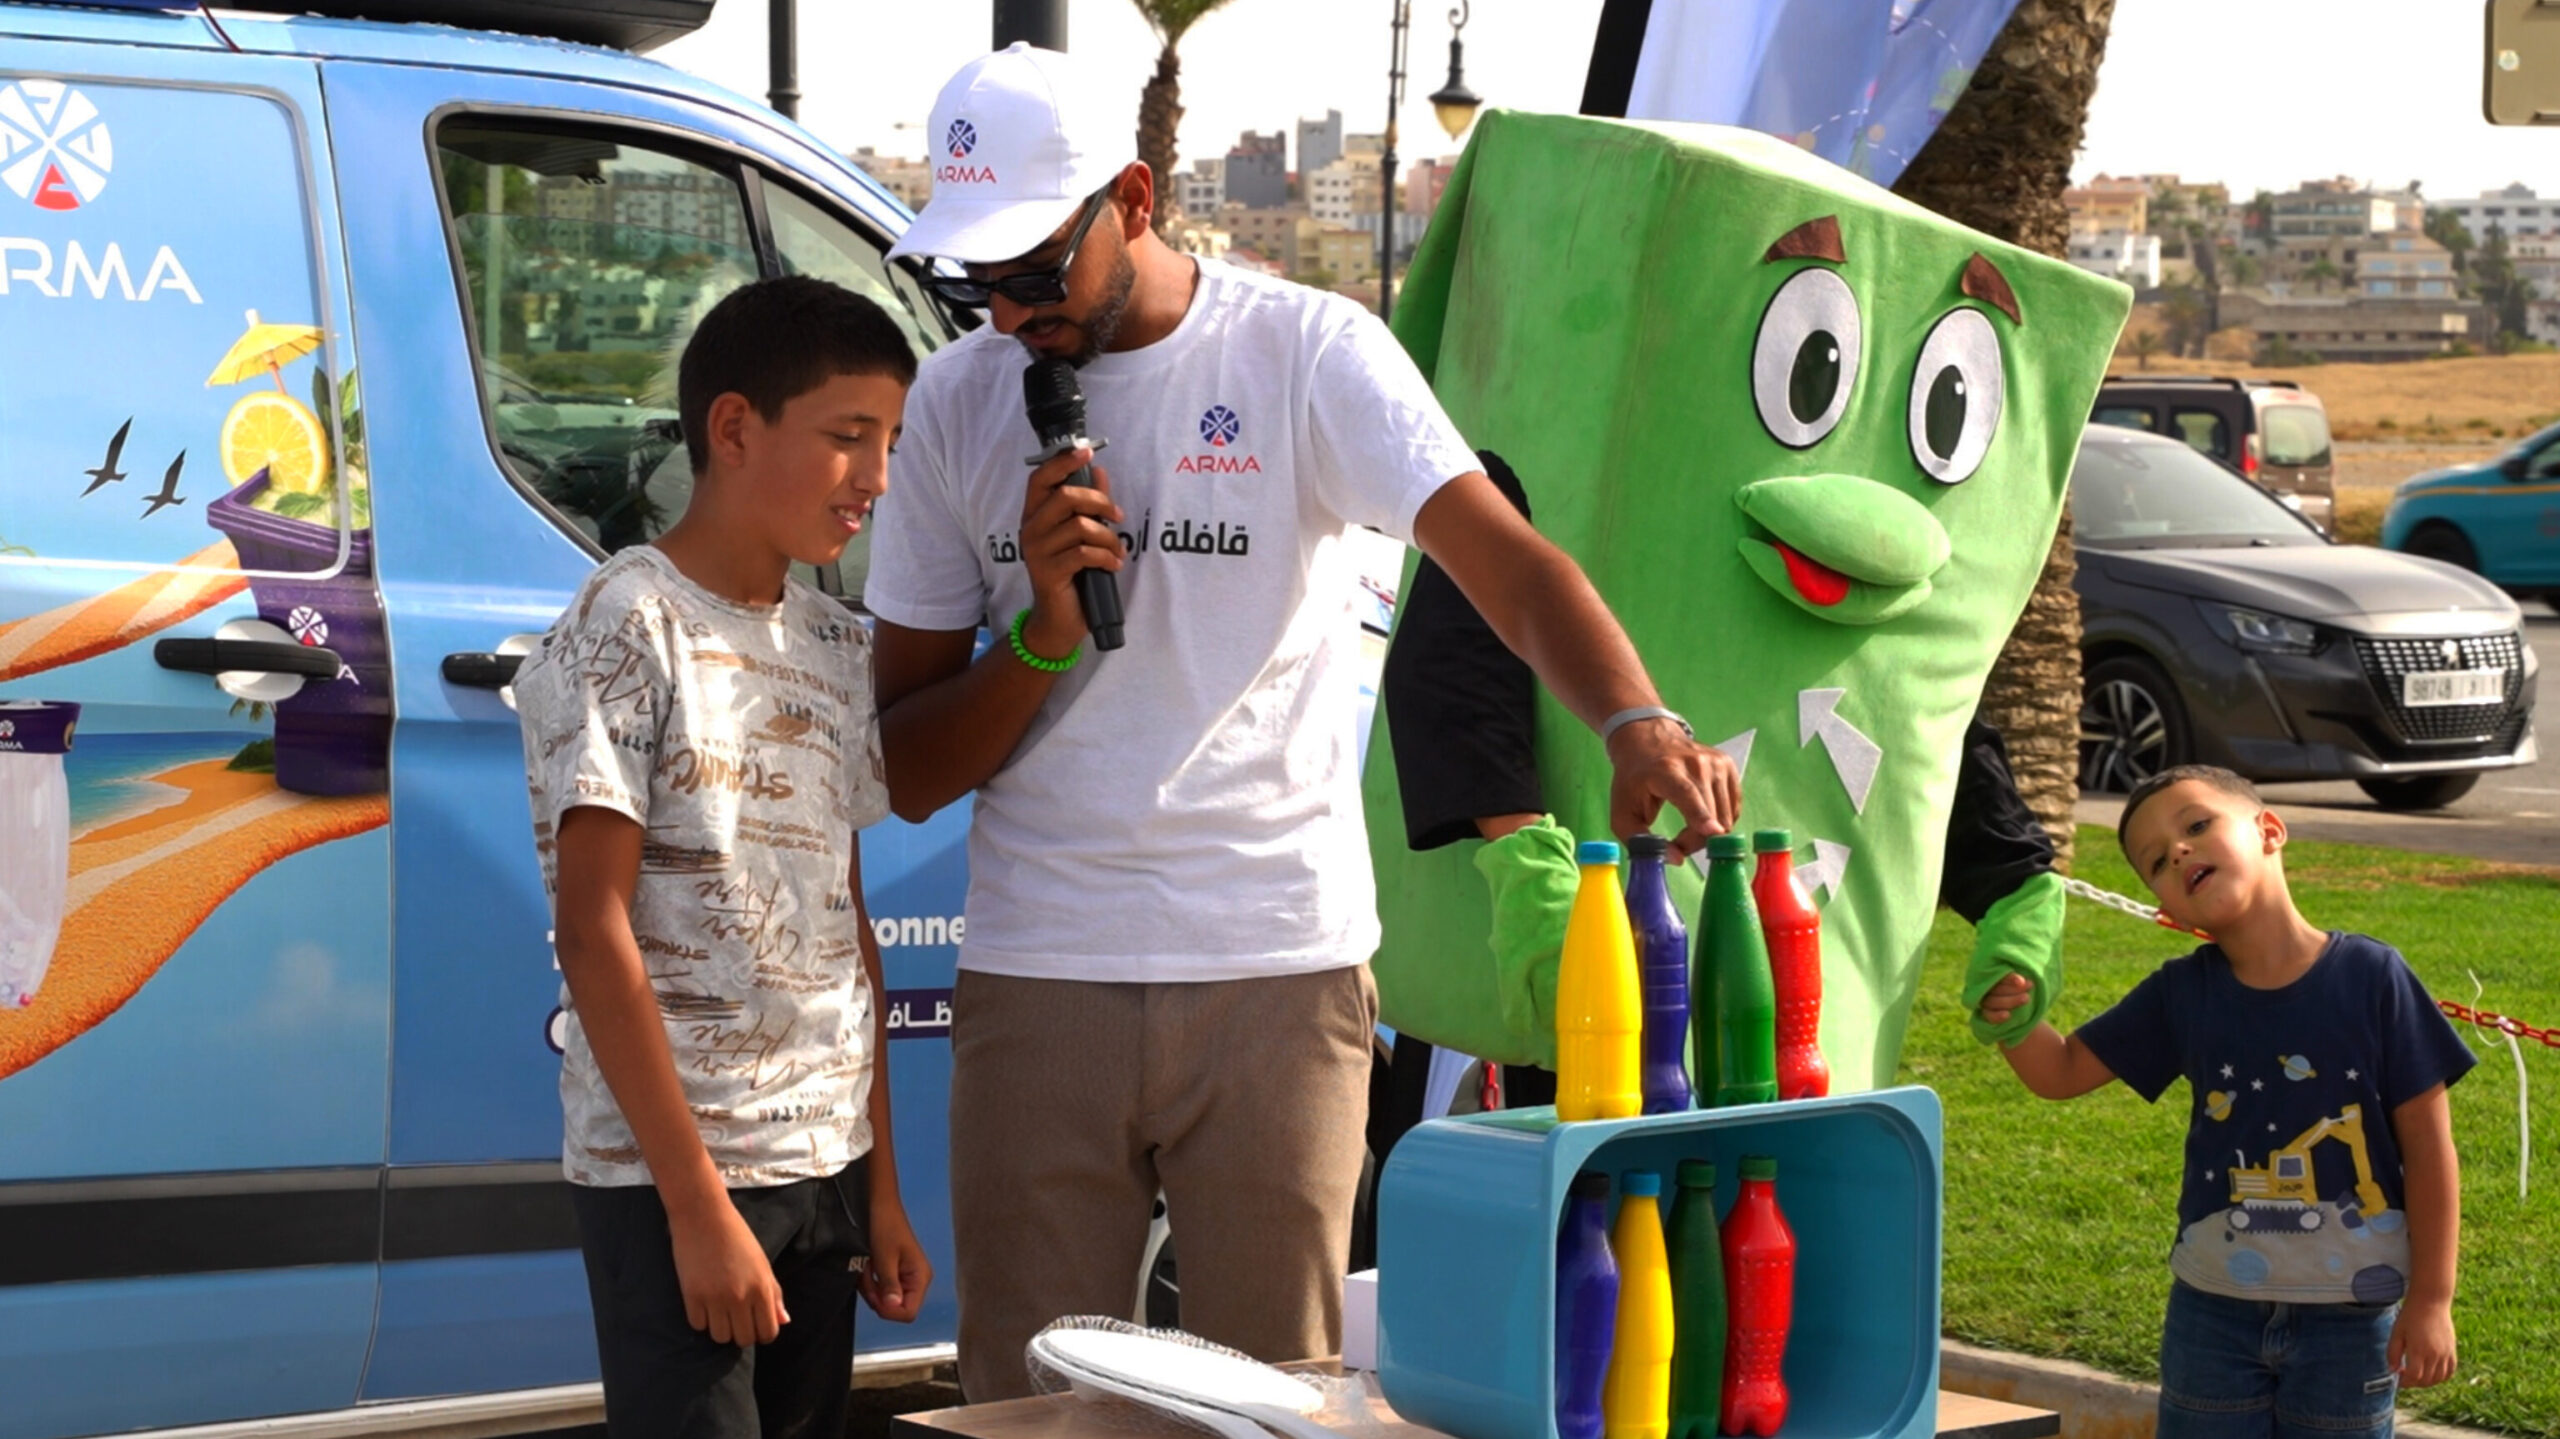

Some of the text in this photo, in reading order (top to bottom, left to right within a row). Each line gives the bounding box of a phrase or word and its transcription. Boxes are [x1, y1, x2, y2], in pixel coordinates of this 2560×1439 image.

[936, 165, 997, 184] ARMA
[0, 236, 204, 304] RMA
[1175, 455, 1261, 473] ARMA
[1159, 519, 1249, 556] قافلة
